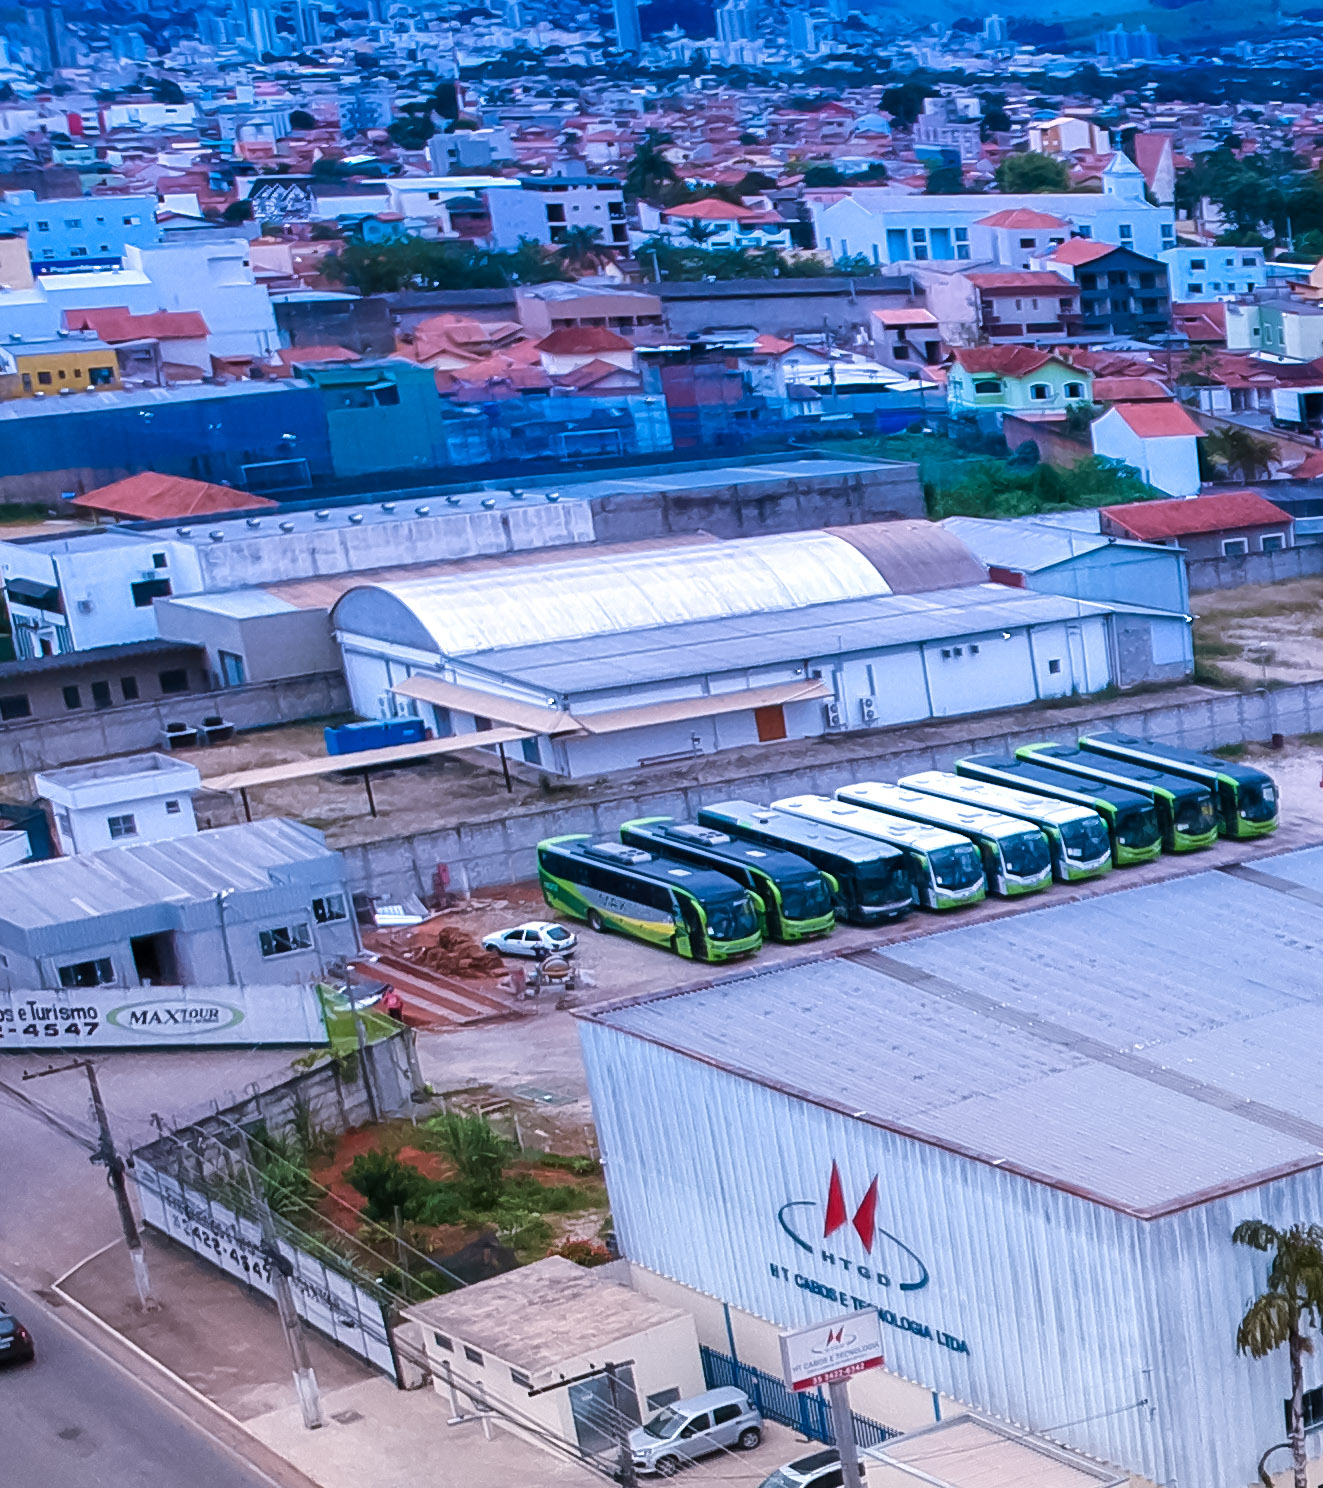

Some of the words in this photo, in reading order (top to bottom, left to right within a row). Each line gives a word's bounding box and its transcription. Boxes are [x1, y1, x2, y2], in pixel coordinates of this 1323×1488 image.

[18, 1008, 27, 1021] e
[27, 1000, 98, 1021] Turismo
[821, 1250, 891, 1288] HTGD
[769, 1262, 789, 1282] HT
[794, 1273, 838, 1302] CABOS
[840, 1291, 849, 1308] E
[936, 1328, 970, 1356] LTDA
